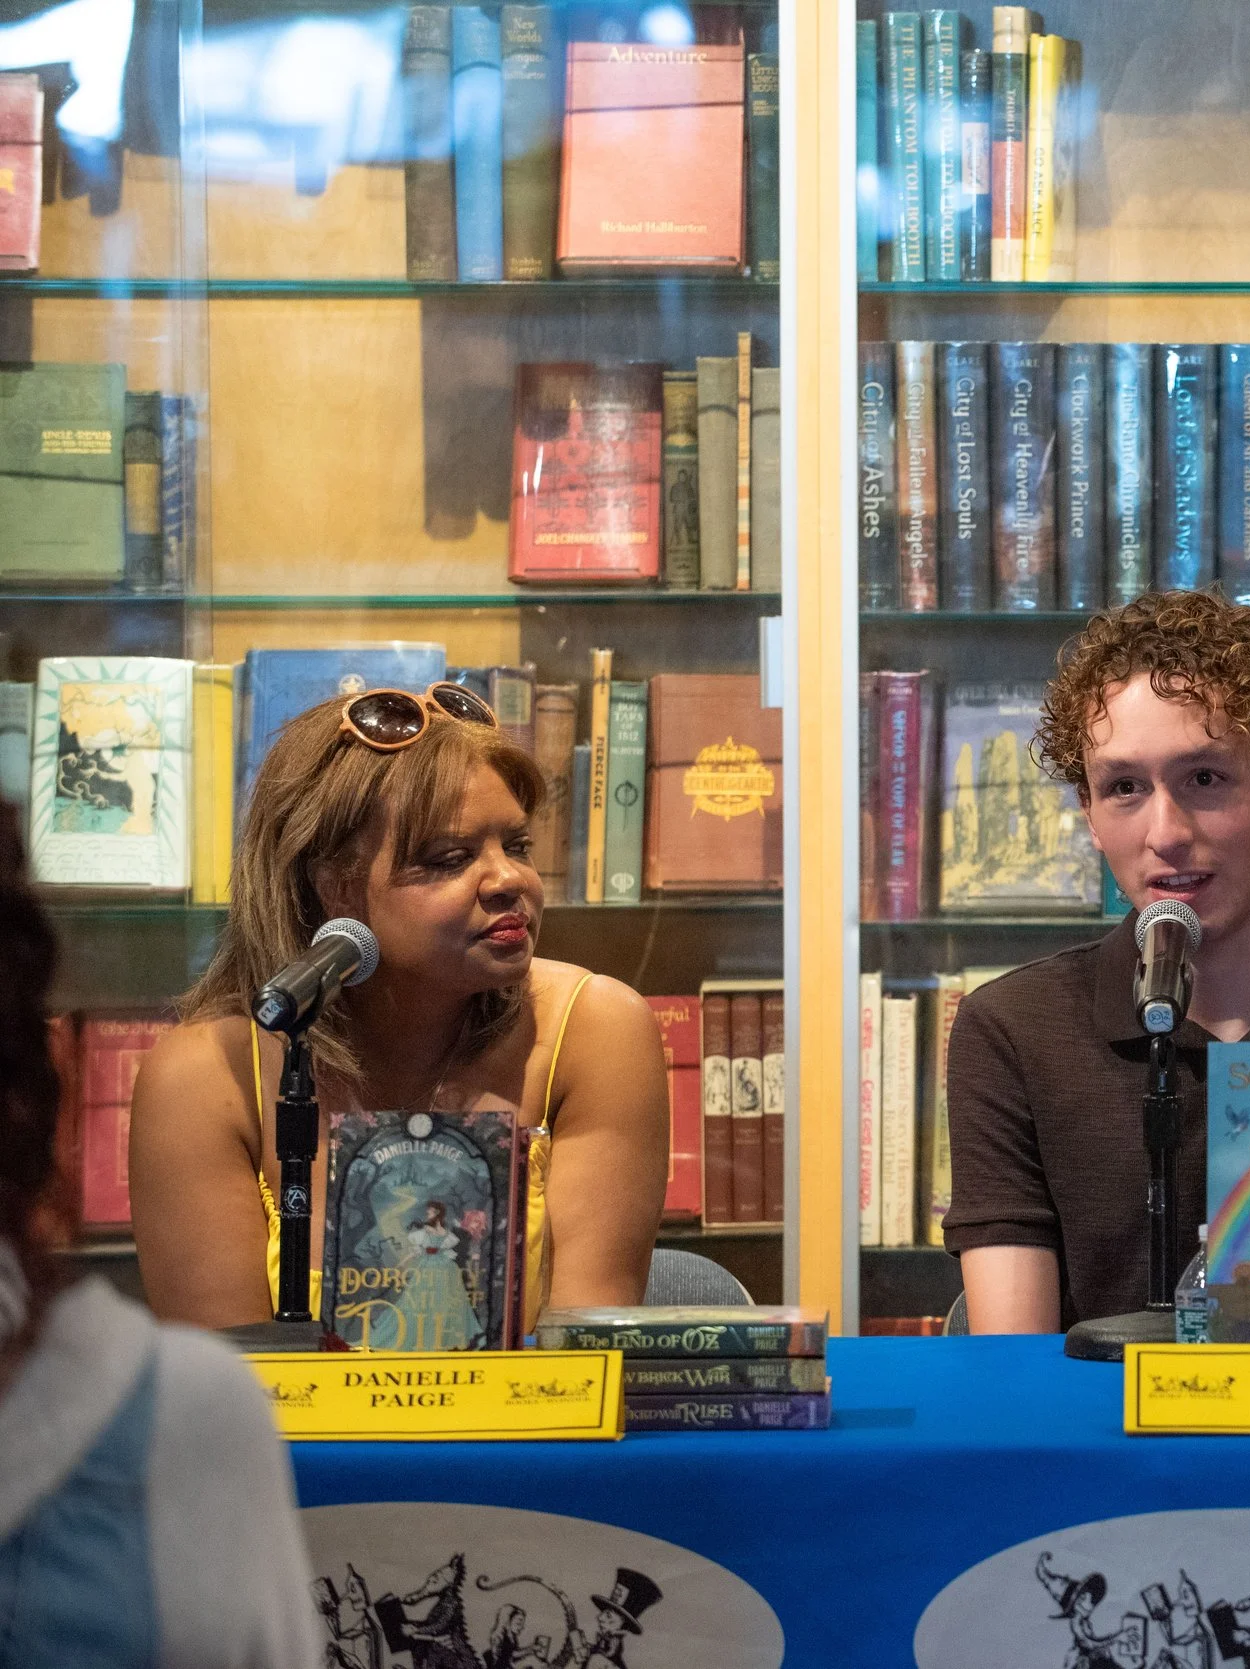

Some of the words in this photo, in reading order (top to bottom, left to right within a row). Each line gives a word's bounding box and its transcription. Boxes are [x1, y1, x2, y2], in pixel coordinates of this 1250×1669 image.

[512, 18, 536, 30] New
[941, 24, 953, 58] THE
[607, 47, 708, 66] Adventure
[901, 24, 915, 60] THE
[903, 65, 919, 155] PHANTOM
[941, 64, 955, 152] PHANTOM
[1035, 147, 1045, 166] GO
[1034, 169, 1043, 198] ASK
[602, 221, 642, 234] Richard
[905, 160, 921, 267] TOLLBOOTH
[942, 159, 956, 265] TOLLBOOTH
[1032, 203, 1043, 238] ALICE
[861, 381, 885, 434] City
[905, 382, 926, 420] City
[952, 377, 976, 417] City
[1010, 378, 1033, 418] City
[955, 422, 974, 438] of
[1012, 421, 1029, 437] of
[1069, 373, 1090, 475] Clockwork
[909, 447, 927, 503] Fallen
[957, 441, 976, 482] Lost
[863, 466, 887, 538] Ashes
[1013, 443, 1035, 530] Heavenly
[958, 488, 977, 541] Souls
[1071, 481, 1090, 539] Prince
[905, 507, 928, 569] Angels
[1015, 535, 1035, 570] Fire
[596, 736, 606, 778] FIERCE
[593, 781, 603, 810] FACE
[373, 1141, 429, 1165] DANIELLE
[431, 1140, 464, 1162] PAIGE
[335, 1299, 468, 1351] DIE
[580, 1333, 610, 1349] The
[612, 1329, 655, 1349] END
[657, 1332, 680, 1349] OF
[681, 1326, 728, 1352] OZ
[746, 1326, 787, 1338] DANIELLE
[753, 1339, 778, 1350] PAIGE
[344, 1370, 485, 1388] DANIELLE
[639, 1370, 685, 1386] BRICK
[684, 1364, 732, 1388] WAR
[746, 1364, 787, 1376] DANIELLE
[753, 1376, 778, 1389] PAIGE
[370, 1393, 456, 1408] PAIGE
[675, 1402, 734, 1427] RISE
[752, 1402, 792, 1414] DANIELLE
[758, 1415, 784, 1426] PAIGE
